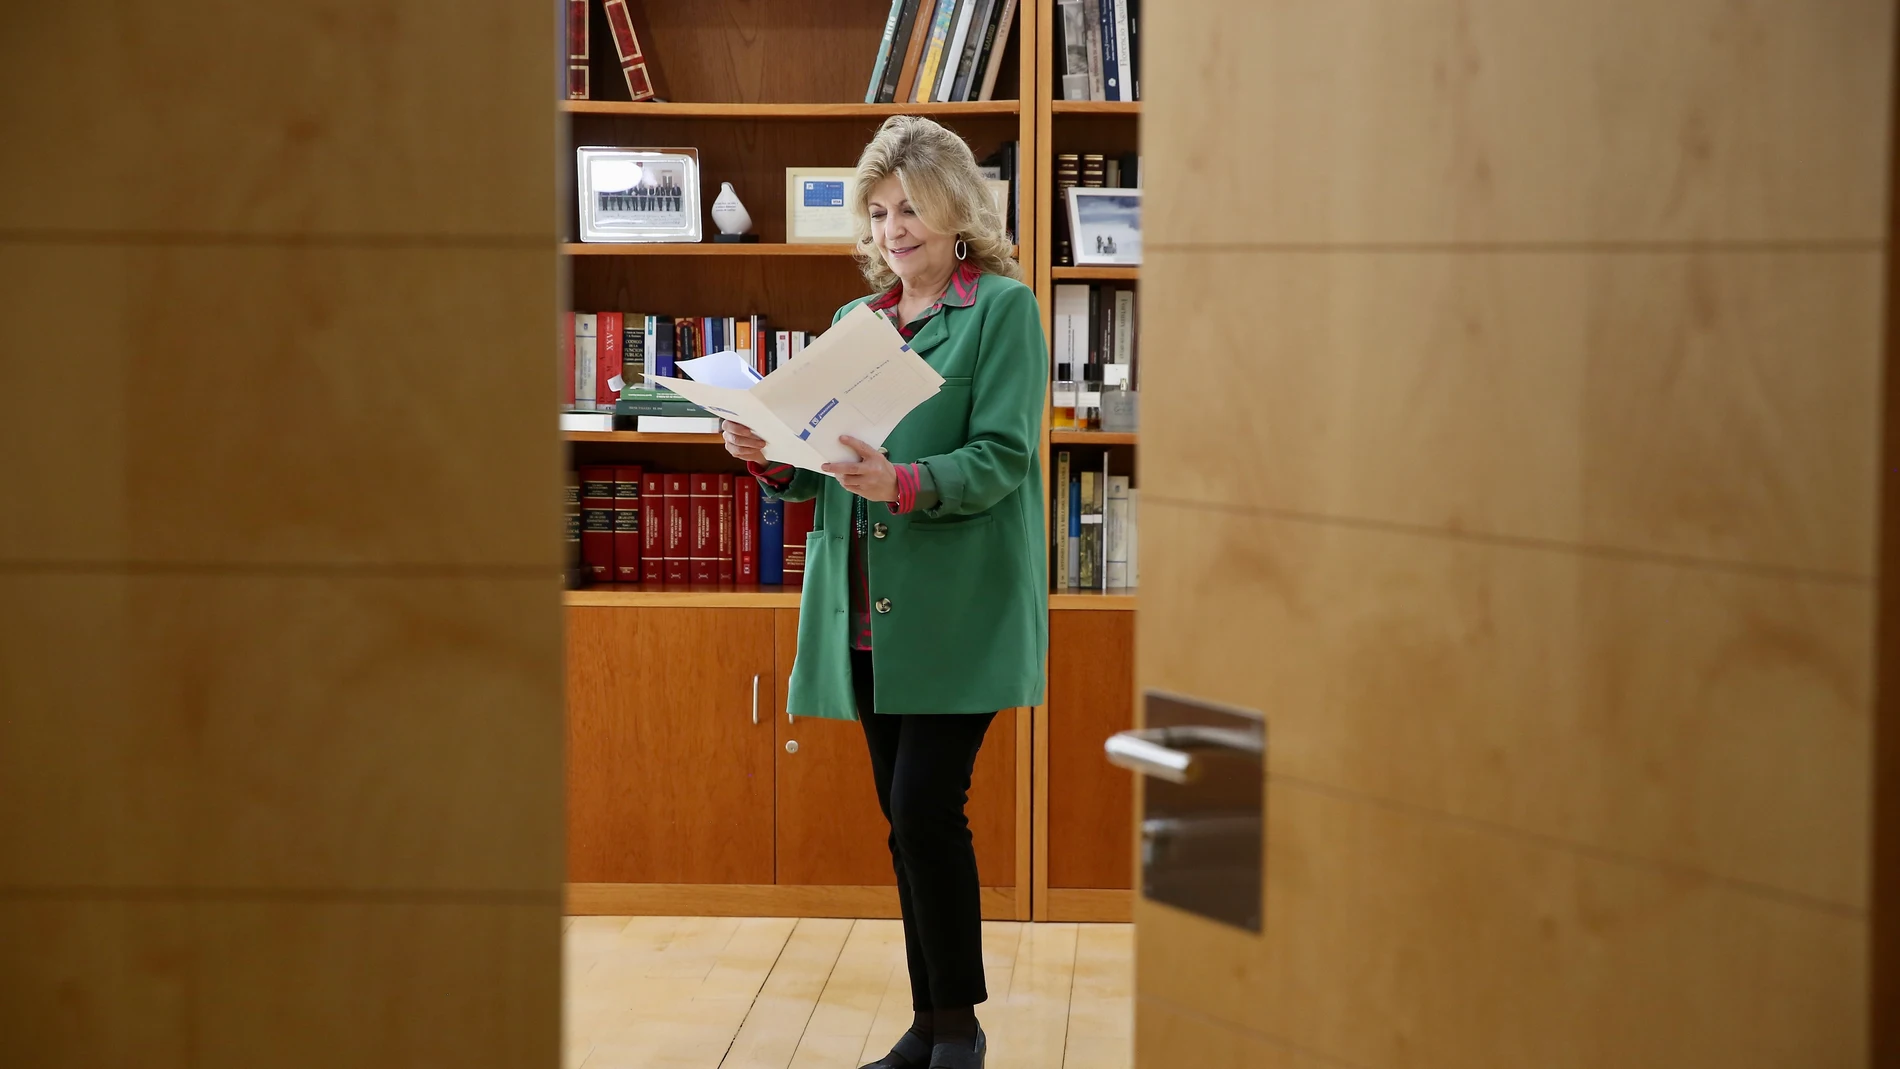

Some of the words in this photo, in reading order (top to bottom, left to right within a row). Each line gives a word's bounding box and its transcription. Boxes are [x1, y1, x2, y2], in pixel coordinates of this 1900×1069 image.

[884, 16, 896, 41] METRO
[983, 23, 996, 51] MADRID
[1119, 28, 1128, 67] Florencio
[606, 332, 614, 351] XXV
